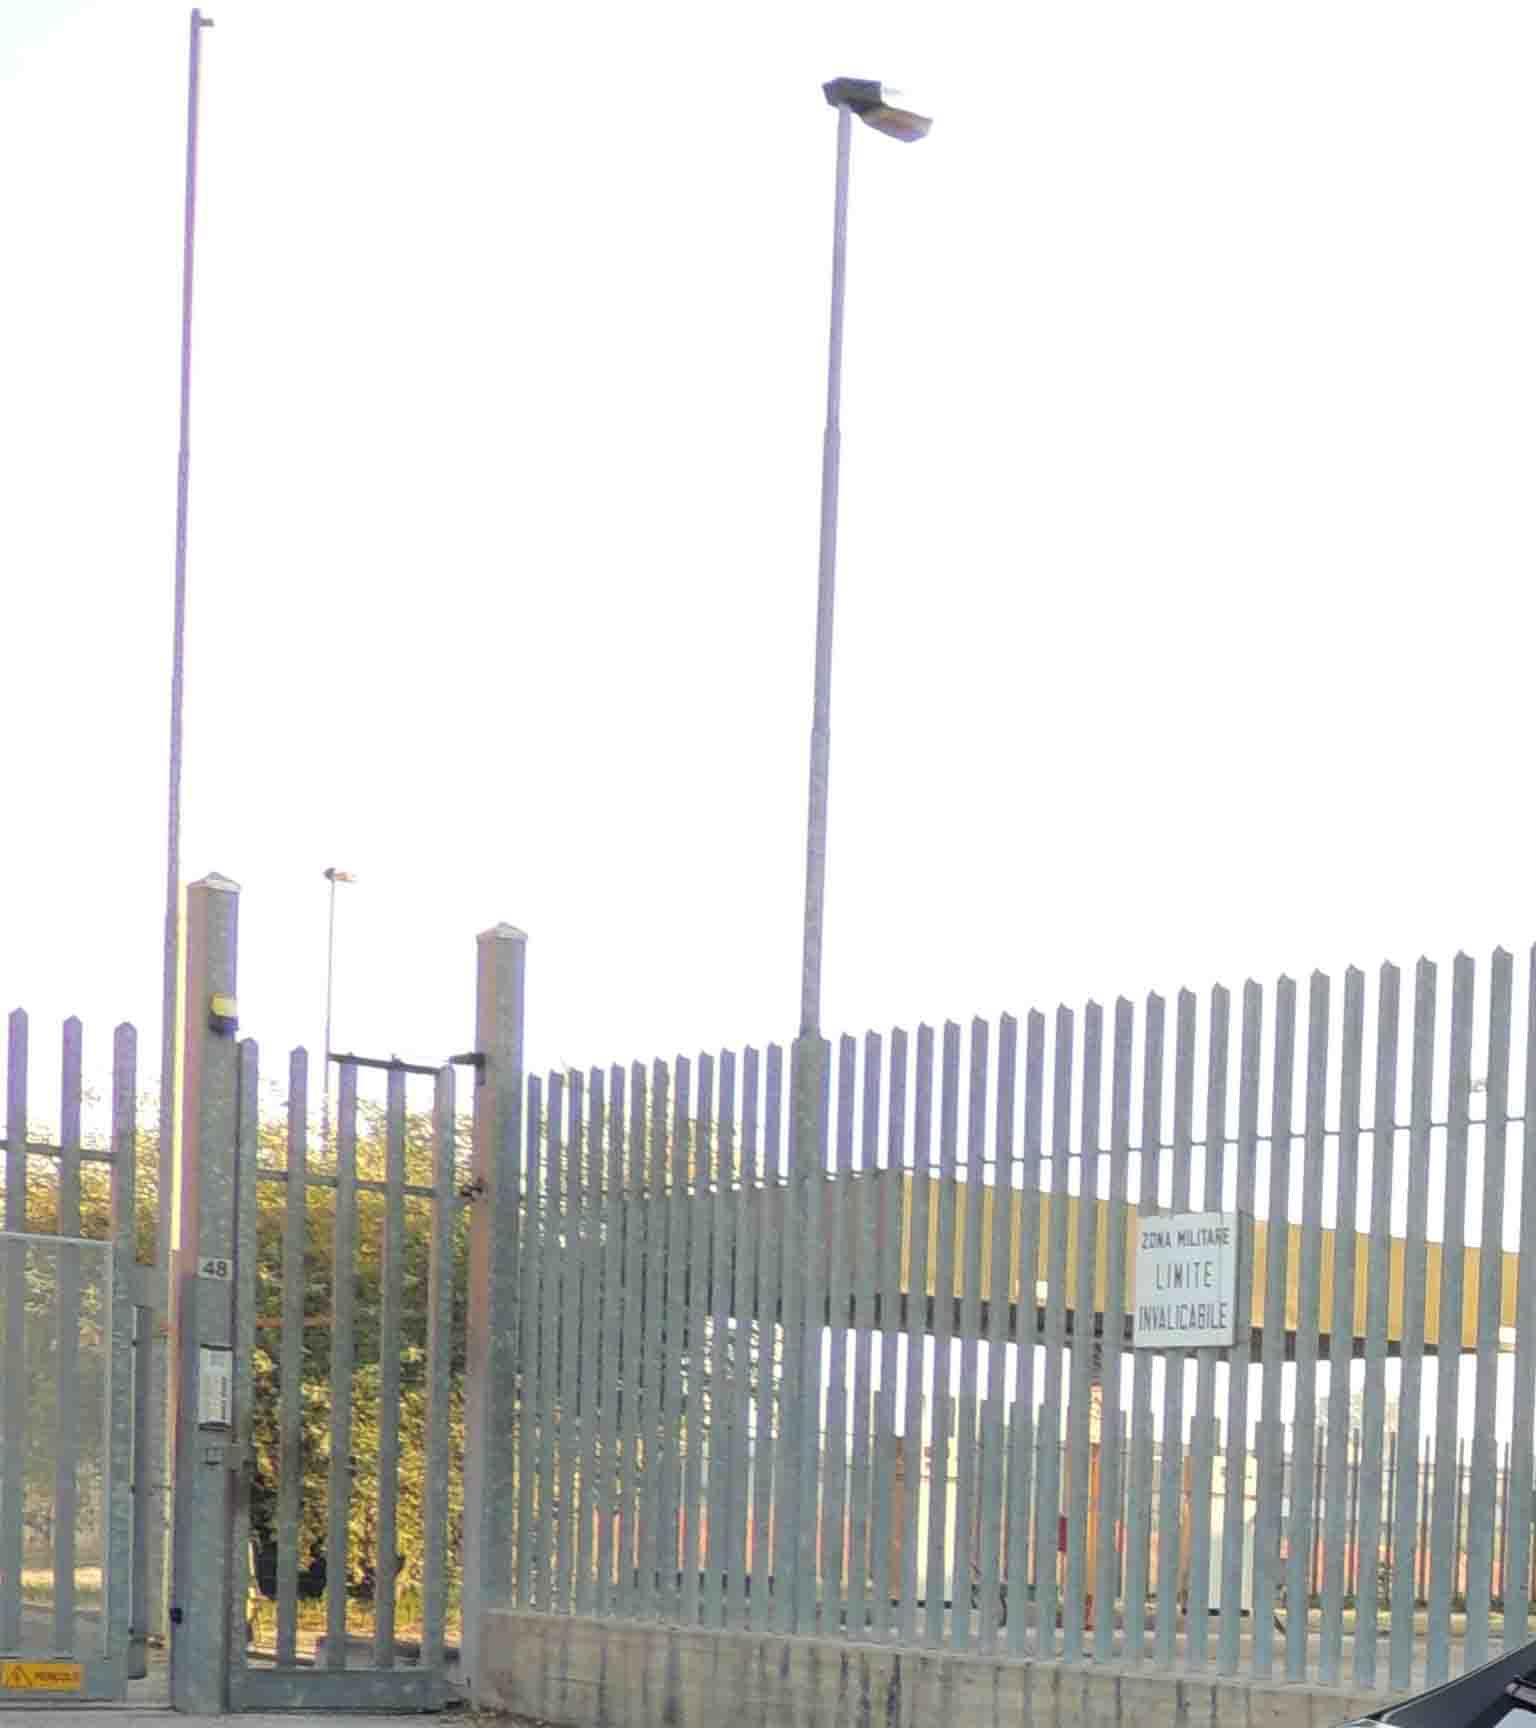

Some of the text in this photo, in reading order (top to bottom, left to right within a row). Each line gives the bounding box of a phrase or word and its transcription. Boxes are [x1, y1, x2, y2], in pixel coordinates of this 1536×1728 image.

[1141, 1227, 1230, 1250] ZONA MILITARE
[203, 1260, 228, 1278] 48
[1155, 1261, 1214, 1290] LIMITE
[1139, 1302, 1228, 1331] INVALICABILE
